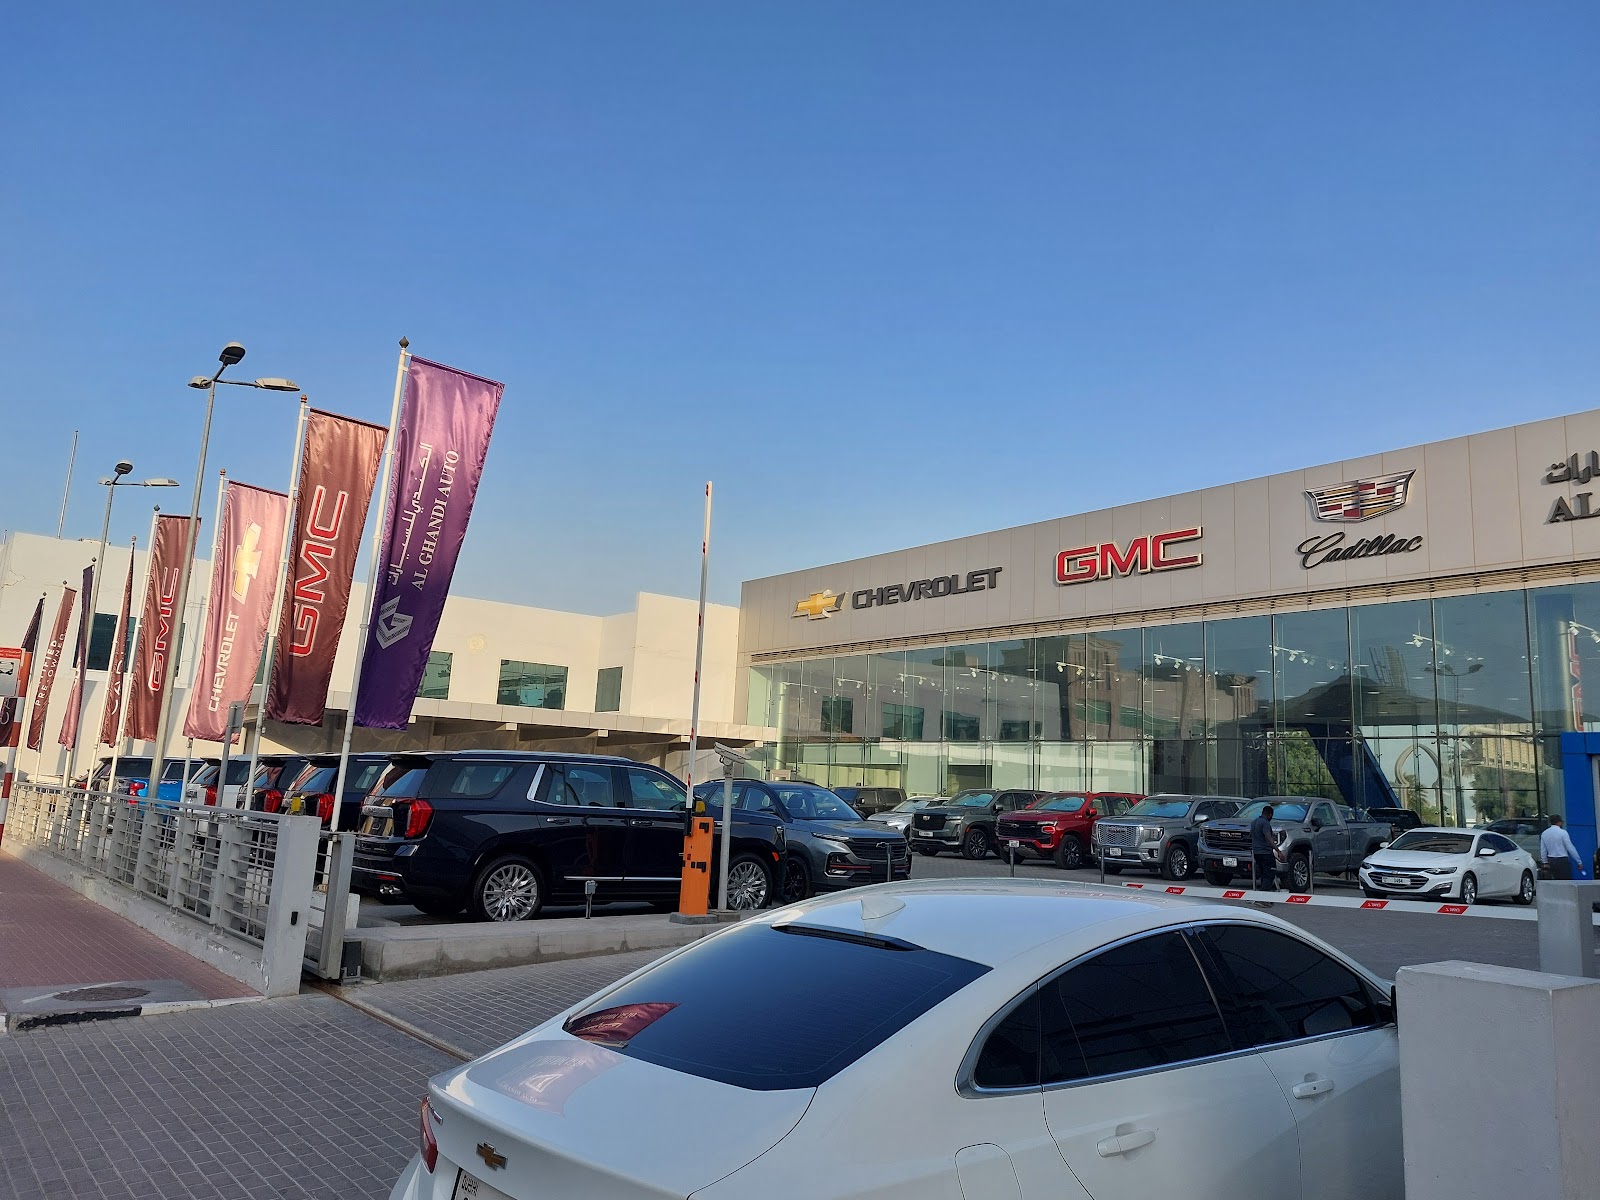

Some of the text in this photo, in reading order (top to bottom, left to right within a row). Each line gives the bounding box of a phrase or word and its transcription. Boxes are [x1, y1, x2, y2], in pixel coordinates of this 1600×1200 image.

[1546, 450, 1600, 484] ارات
[411, 450, 460, 591] AL GHANDI AUTO
[1549, 492, 1600, 523] AL
[289, 484, 348, 657] GMC
[1055, 526, 1203, 585] GMC
[1298, 531, 1423, 570] Cadillac
[851, 566, 1003, 610] CHEVROLET
[148, 566, 179, 691] GMC
[208, 610, 240, 713] CHEVROLET
